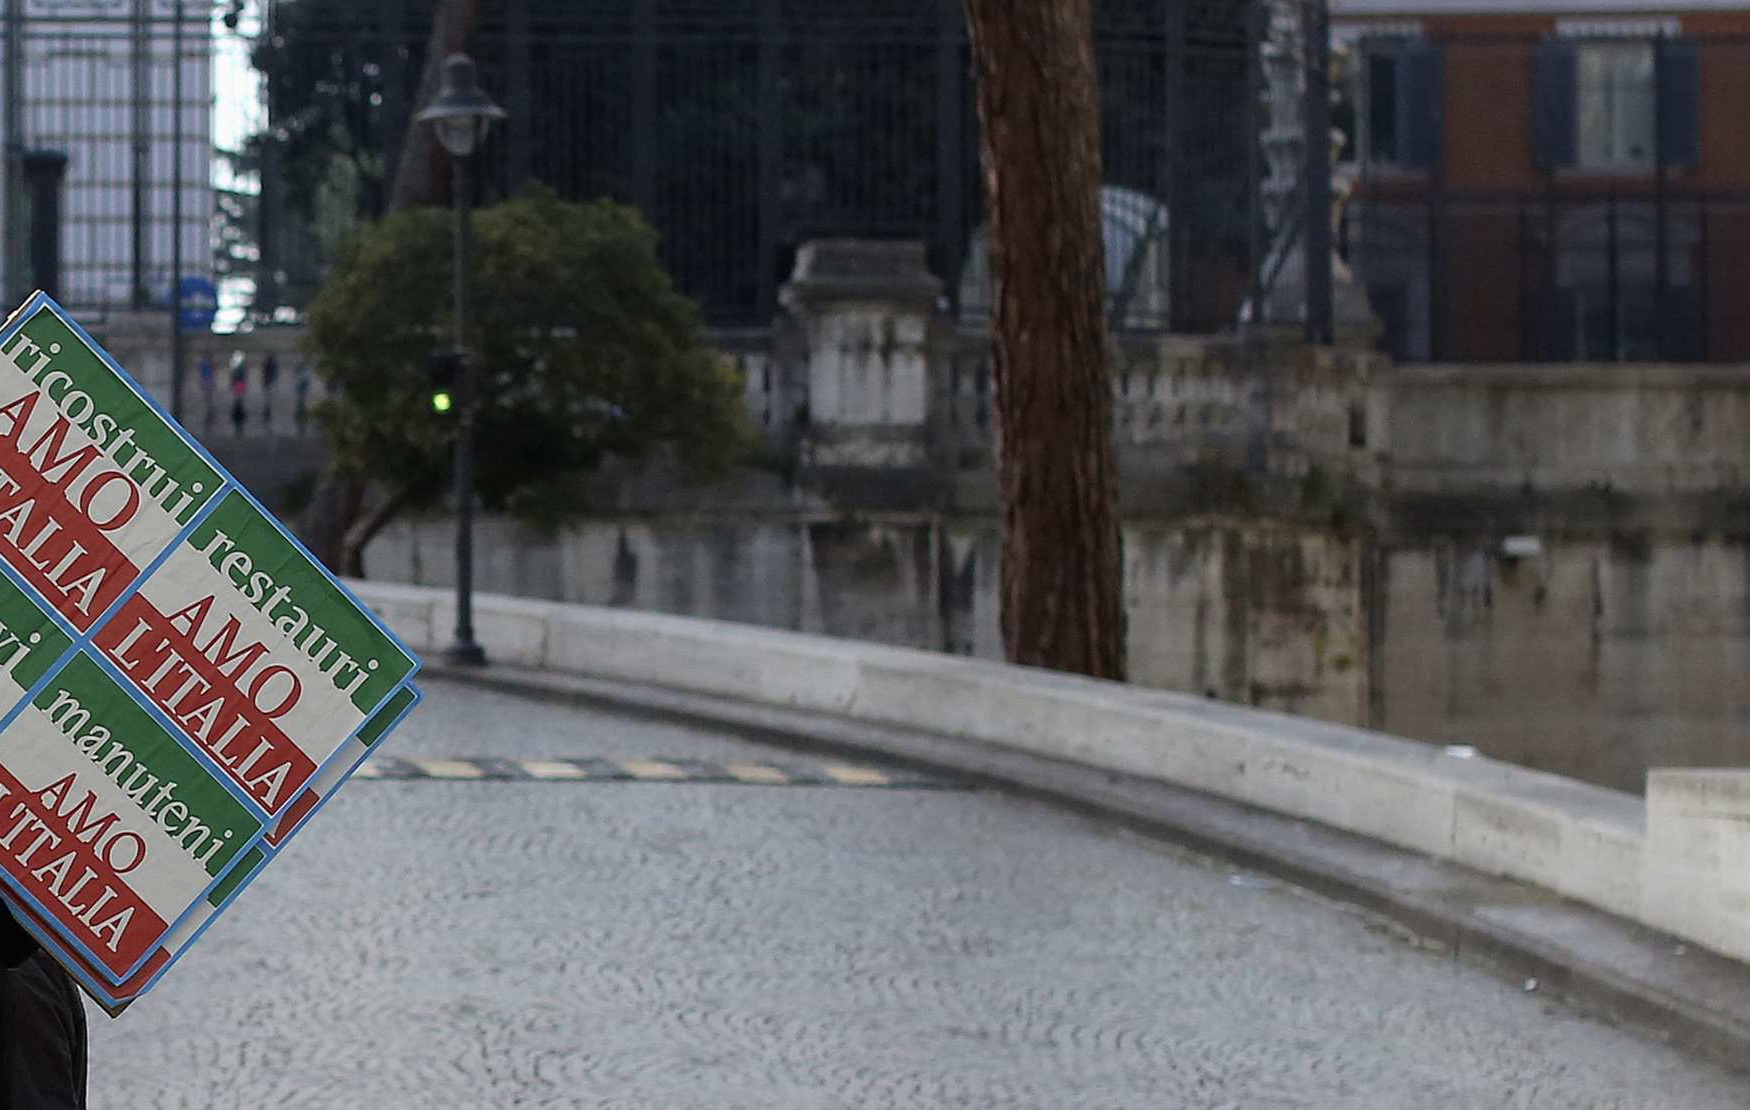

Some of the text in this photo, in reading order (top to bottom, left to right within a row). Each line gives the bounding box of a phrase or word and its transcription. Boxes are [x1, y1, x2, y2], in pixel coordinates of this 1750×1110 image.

[6, 333, 203, 520] ricostrui
[166, 595, 303, 718] AMO
[201, 529, 380, 698] restauri
[41, 689, 234, 871] manuteni
[108, 617, 292, 808] L'ITALIA
[30, 772, 147, 874] AMO
